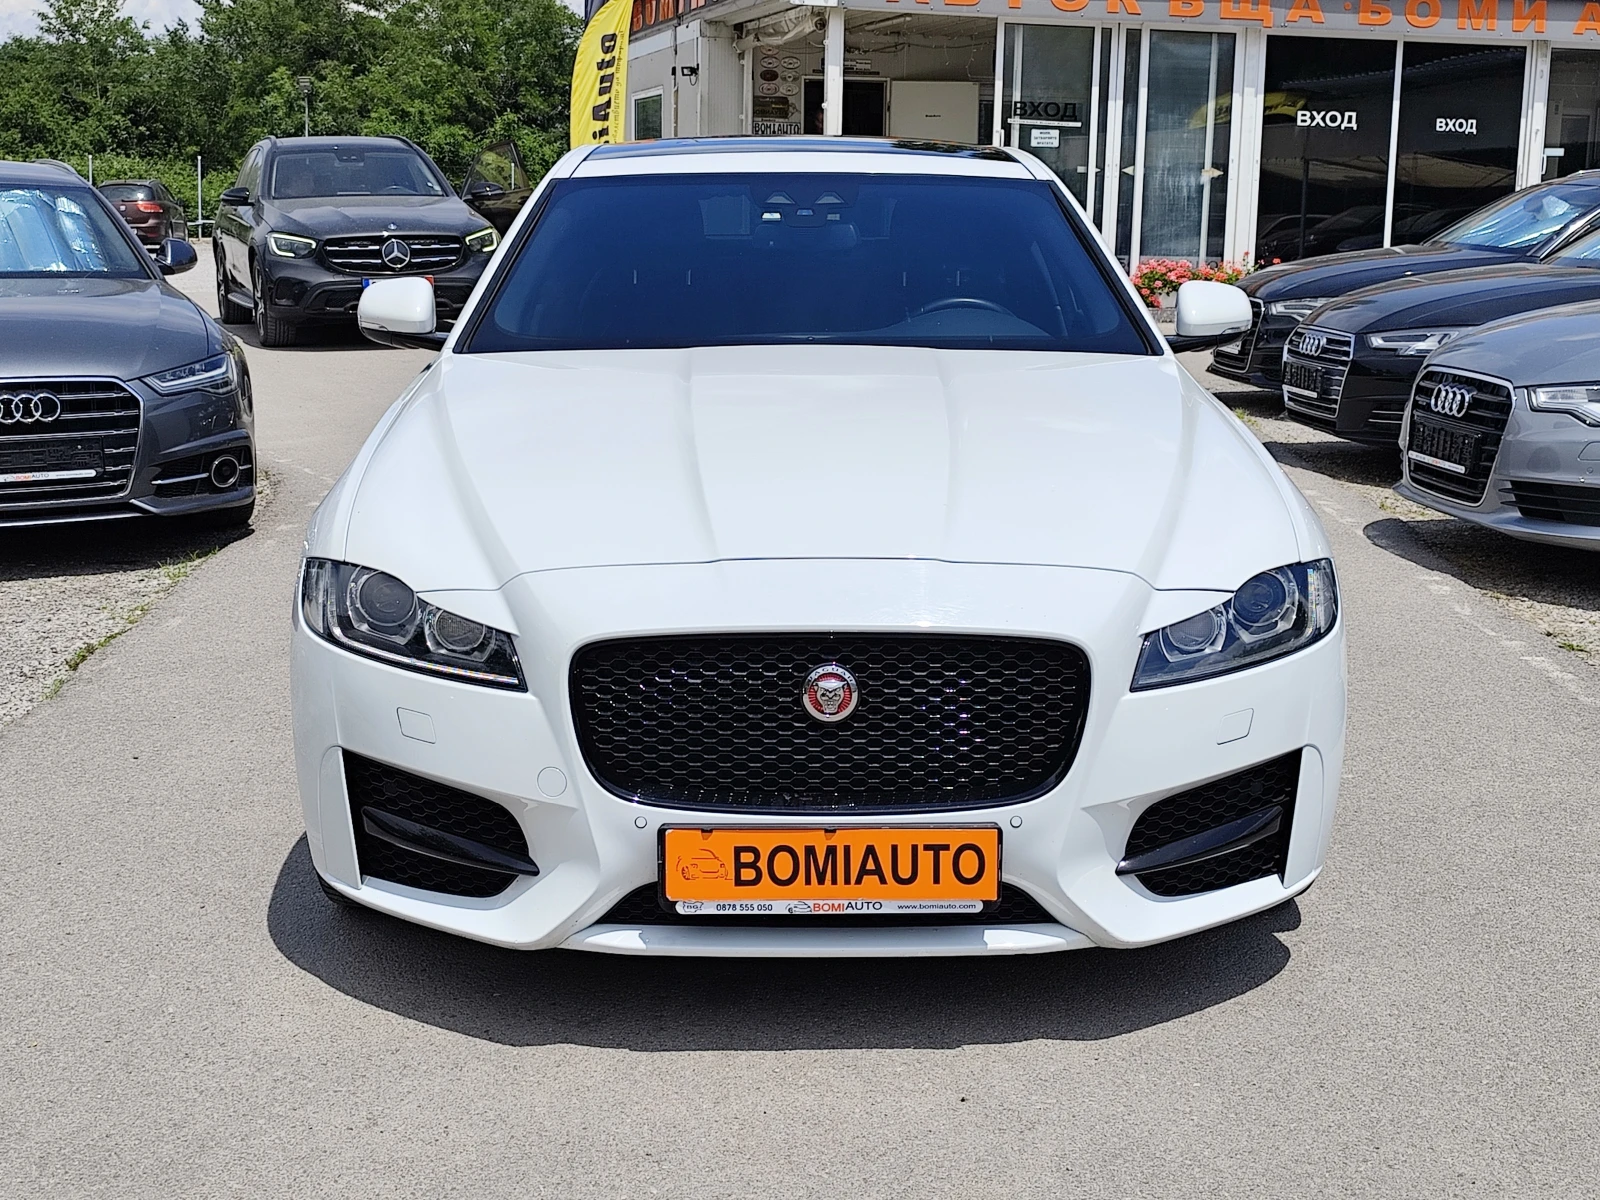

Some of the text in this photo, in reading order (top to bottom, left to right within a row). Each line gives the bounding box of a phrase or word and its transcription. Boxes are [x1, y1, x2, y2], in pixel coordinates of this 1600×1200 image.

[1358, 0, 1548, 33] БОМИ
[592, 33, 618, 144] iAuto
[1014, 101, 1078, 121] ВХОД
[1296, 110, 1358, 130] ВХОД
[754, 122, 801, 135] BOMIAUTO
[1435, 118, 1477, 134] ВХОД
[807, 667, 854, 682] JAGUAR
[733, 843, 986, 887] BOMIAUTO
[716, 903, 737, 912] 0878
[739, 903, 755, 912] 555
[757, 903, 773, 912] 050
[813, 901, 883, 912] BOMIAUTO
